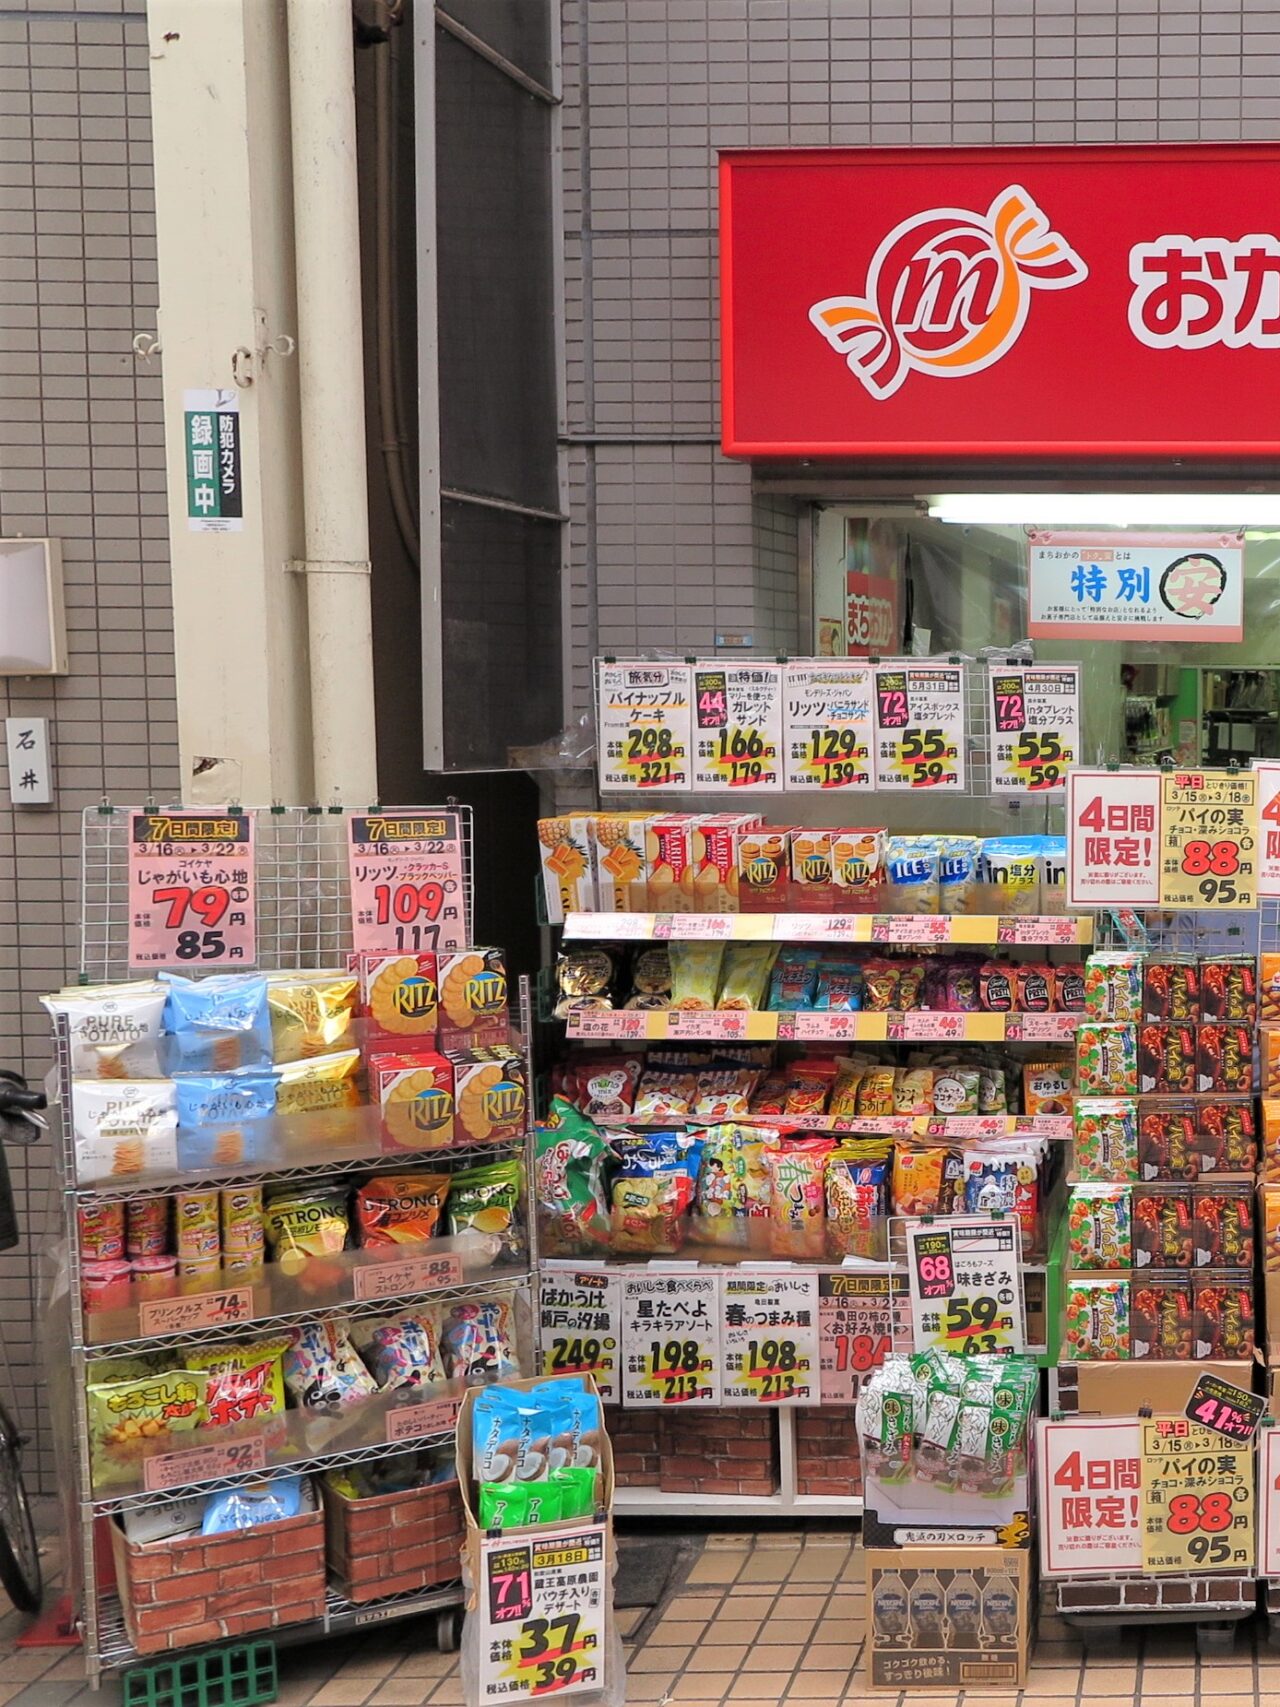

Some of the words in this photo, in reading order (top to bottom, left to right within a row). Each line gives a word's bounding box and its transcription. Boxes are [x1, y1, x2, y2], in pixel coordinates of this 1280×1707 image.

[219, 415, 235, 494] 防犯カメラ
[191, 414, 215, 514] 録画中
[1071, 564, 1150, 603] 特別
[912, 682, 946, 691] 5月31日
[1027, 684, 1061, 693] 4月30日
[732, 701, 771, 713] ガレット
[789, 701, 826, 717] リッツ
[879, 692, 906, 713] 72
[909, 703, 959, 712] アイスボックス
[996, 695, 1022, 717] 72
[630, 709, 665, 722] ケーキ
[737, 715, 766, 726] サンド
[914, 712, 955, 721] 塩タブレット
[1028, 715, 1074, 725] 塩分プラス
[607, 741, 623, 749] 本体
[16, 730, 39, 791] 石井
[606, 774, 637, 783] 税込価格
[1174, 774, 1204, 790] 平日
[1078, 796, 1155, 834] 4日間
[1179, 807, 1244, 826] パイの実
[149, 817, 239, 842] 7日間限定!
[366, 818, 445, 841] 7日間限定!
[1084, 836, 1151, 867] 限定!
[138, 868, 248, 885] じゃがいも心地
[355, 864, 396, 882] リッツ
[1010, 864, 1036, 877] 塩分
[394, 983, 436, 1013] RITZ
[465, 978, 506, 1010] RITZ
[1116, 975, 1129, 1020] パイの実
[1109, 1037, 1125, 1083] パイの実
[1033, 1080, 1068, 1091] おゆるし
[412, 1095, 453, 1126] RITZ
[483, 1087, 524, 1120] RITZ
[363, 1193, 441, 1212] STRONG
[271, 1206, 347, 1230] STRONG
[919, 1256, 950, 1281] 68
[955, 1259, 994, 1268] はごろもフーズ
[375, 1280, 415, 1293] ストロング
[378, 1272, 412, 1284] コイケヤ
[957, 1273, 1012, 1287] 味きざみ
[541, 1290, 605, 1307] ばかうけ
[150, 1303, 203, 1319] プリングルス
[636, 1300, 707, 1319] 星たべよ
[725, 1304, 811, 1327] 春のつまみ種
[630, 1320, 713, 1332] キラキラアソート
[1155, 1420, 1188, 1438] 平日
[483, 1416, 501, 1470] ナタデココ
[516, 1415, 533, 1469] ナタデココ
[1054, 1451, 1141, 1492] 4日間
[1162, 1455, 1237, 1477] パイの実
[1151, 1475, 1244, 1489] チョコ・深みショコラ
[1061, 1496, 1140, 1529] 限定!
[492, 1571, 530, 1605] 71
[536, 1587, 590, 1603] パウチ入り
[544, 1600, 582, 1615] デザート
[486, 1680, 530, 1695] 税込価格
